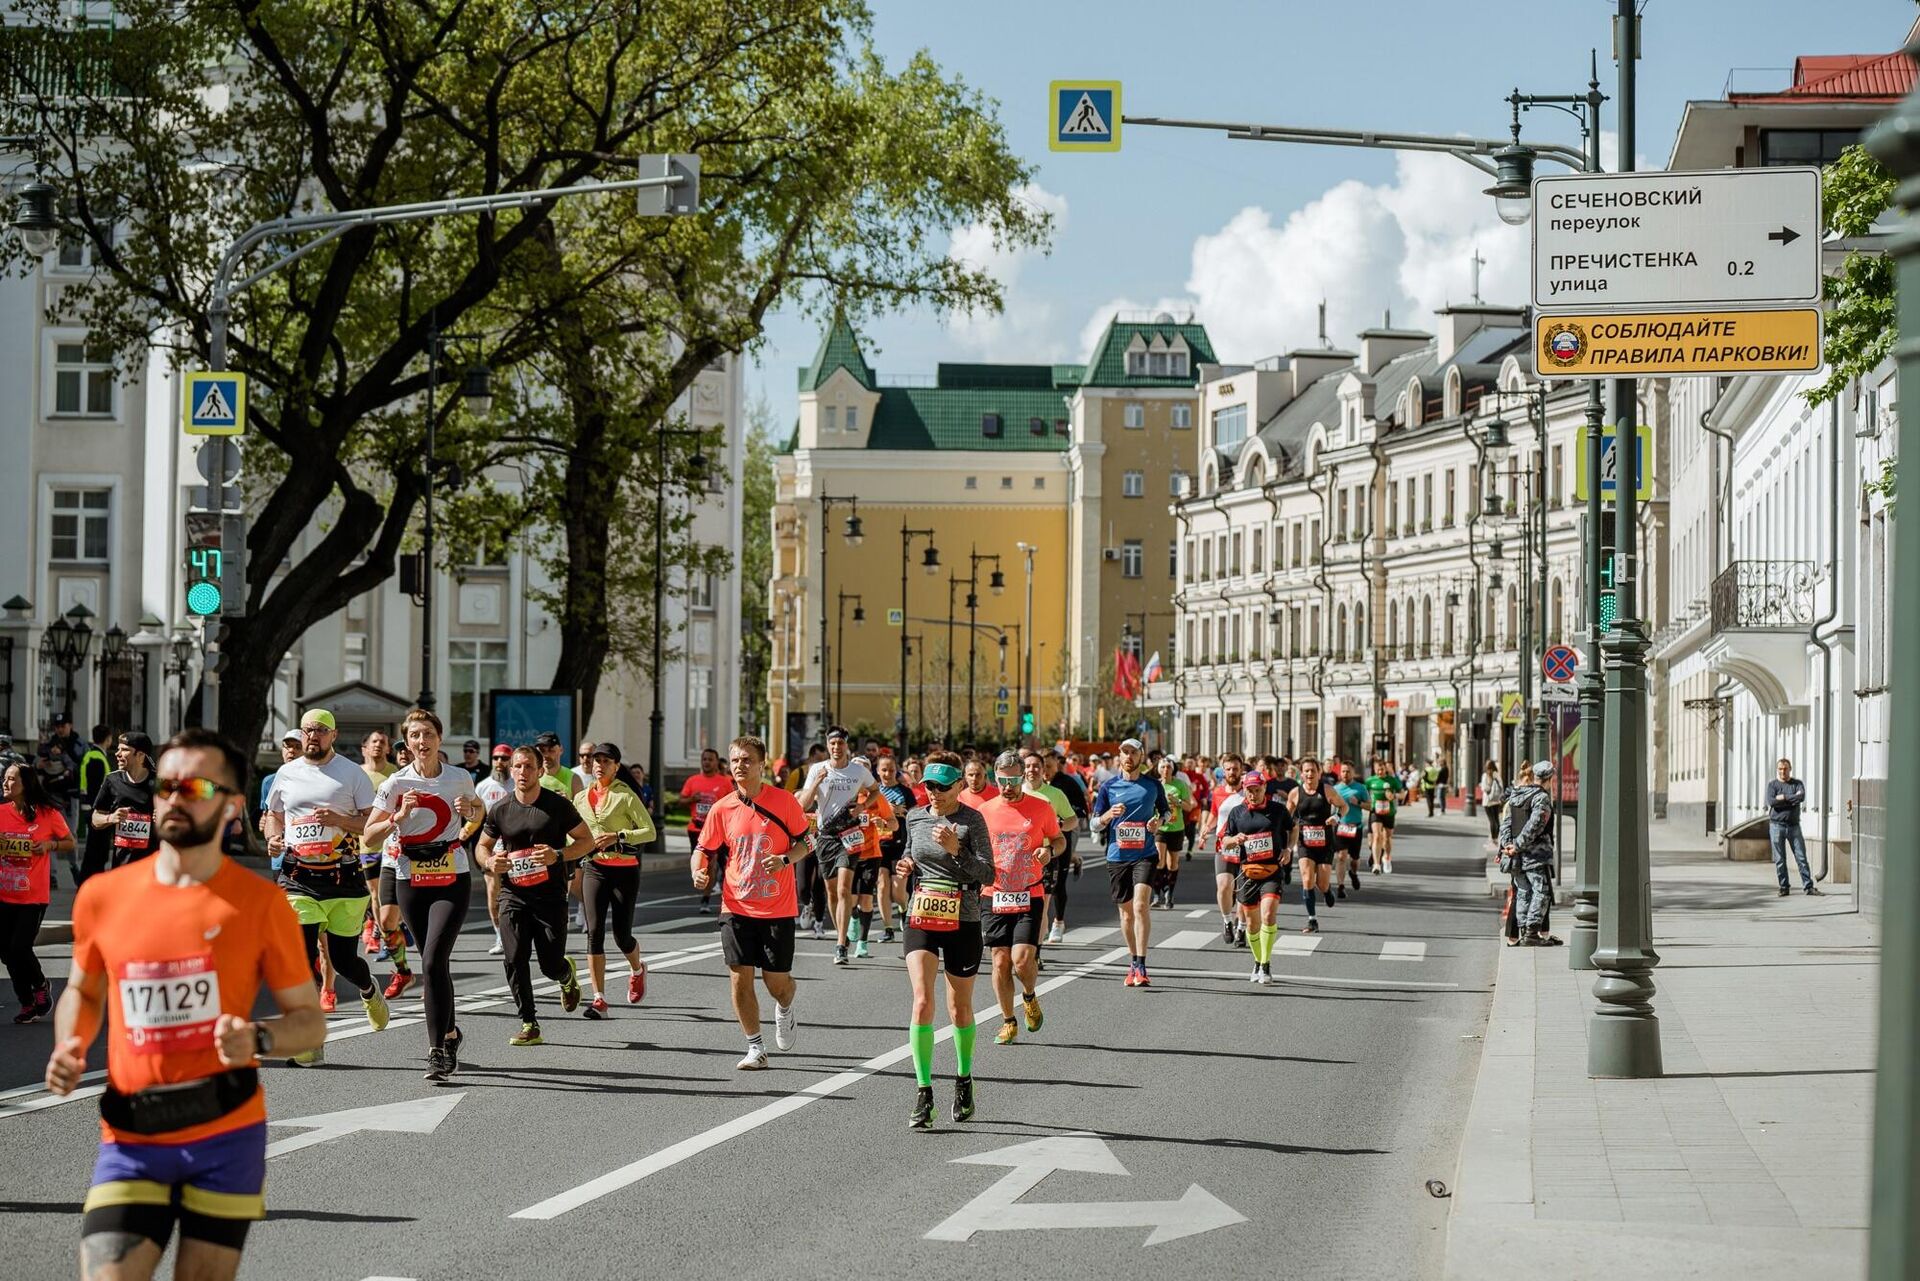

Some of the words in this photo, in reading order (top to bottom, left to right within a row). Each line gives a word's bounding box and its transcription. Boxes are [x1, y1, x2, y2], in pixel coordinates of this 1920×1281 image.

[1550, 186, 1702, 209] СЕЧЕНОВСКИЙ
[1550, 216, 1641, 233] переулок
[1550, 251, 1698, 270] ПРЕЧИСТЕНКА
[1727, 260, 1755, 277] 0.2
[1550, 278, 1608, 295] улица
[1591, 318, 1737, 341] СОБЛЮДАЙТЕ
[1590, 347, 1686, 365] ПРАВИЛА
[1691, 345, 1809, 363] ПАРКОВКИ!
[191, 549, 222, 578] 47
[295, 824, 325, 839] 3237
[1119, 828, 1141, 837] 8076
[1248, 838, 1269, 850] 6736
[916, 896, 957, 913] 10883
[995, 893, 1029, 904] 16362
[127, 979, 210, 1013] 17129
